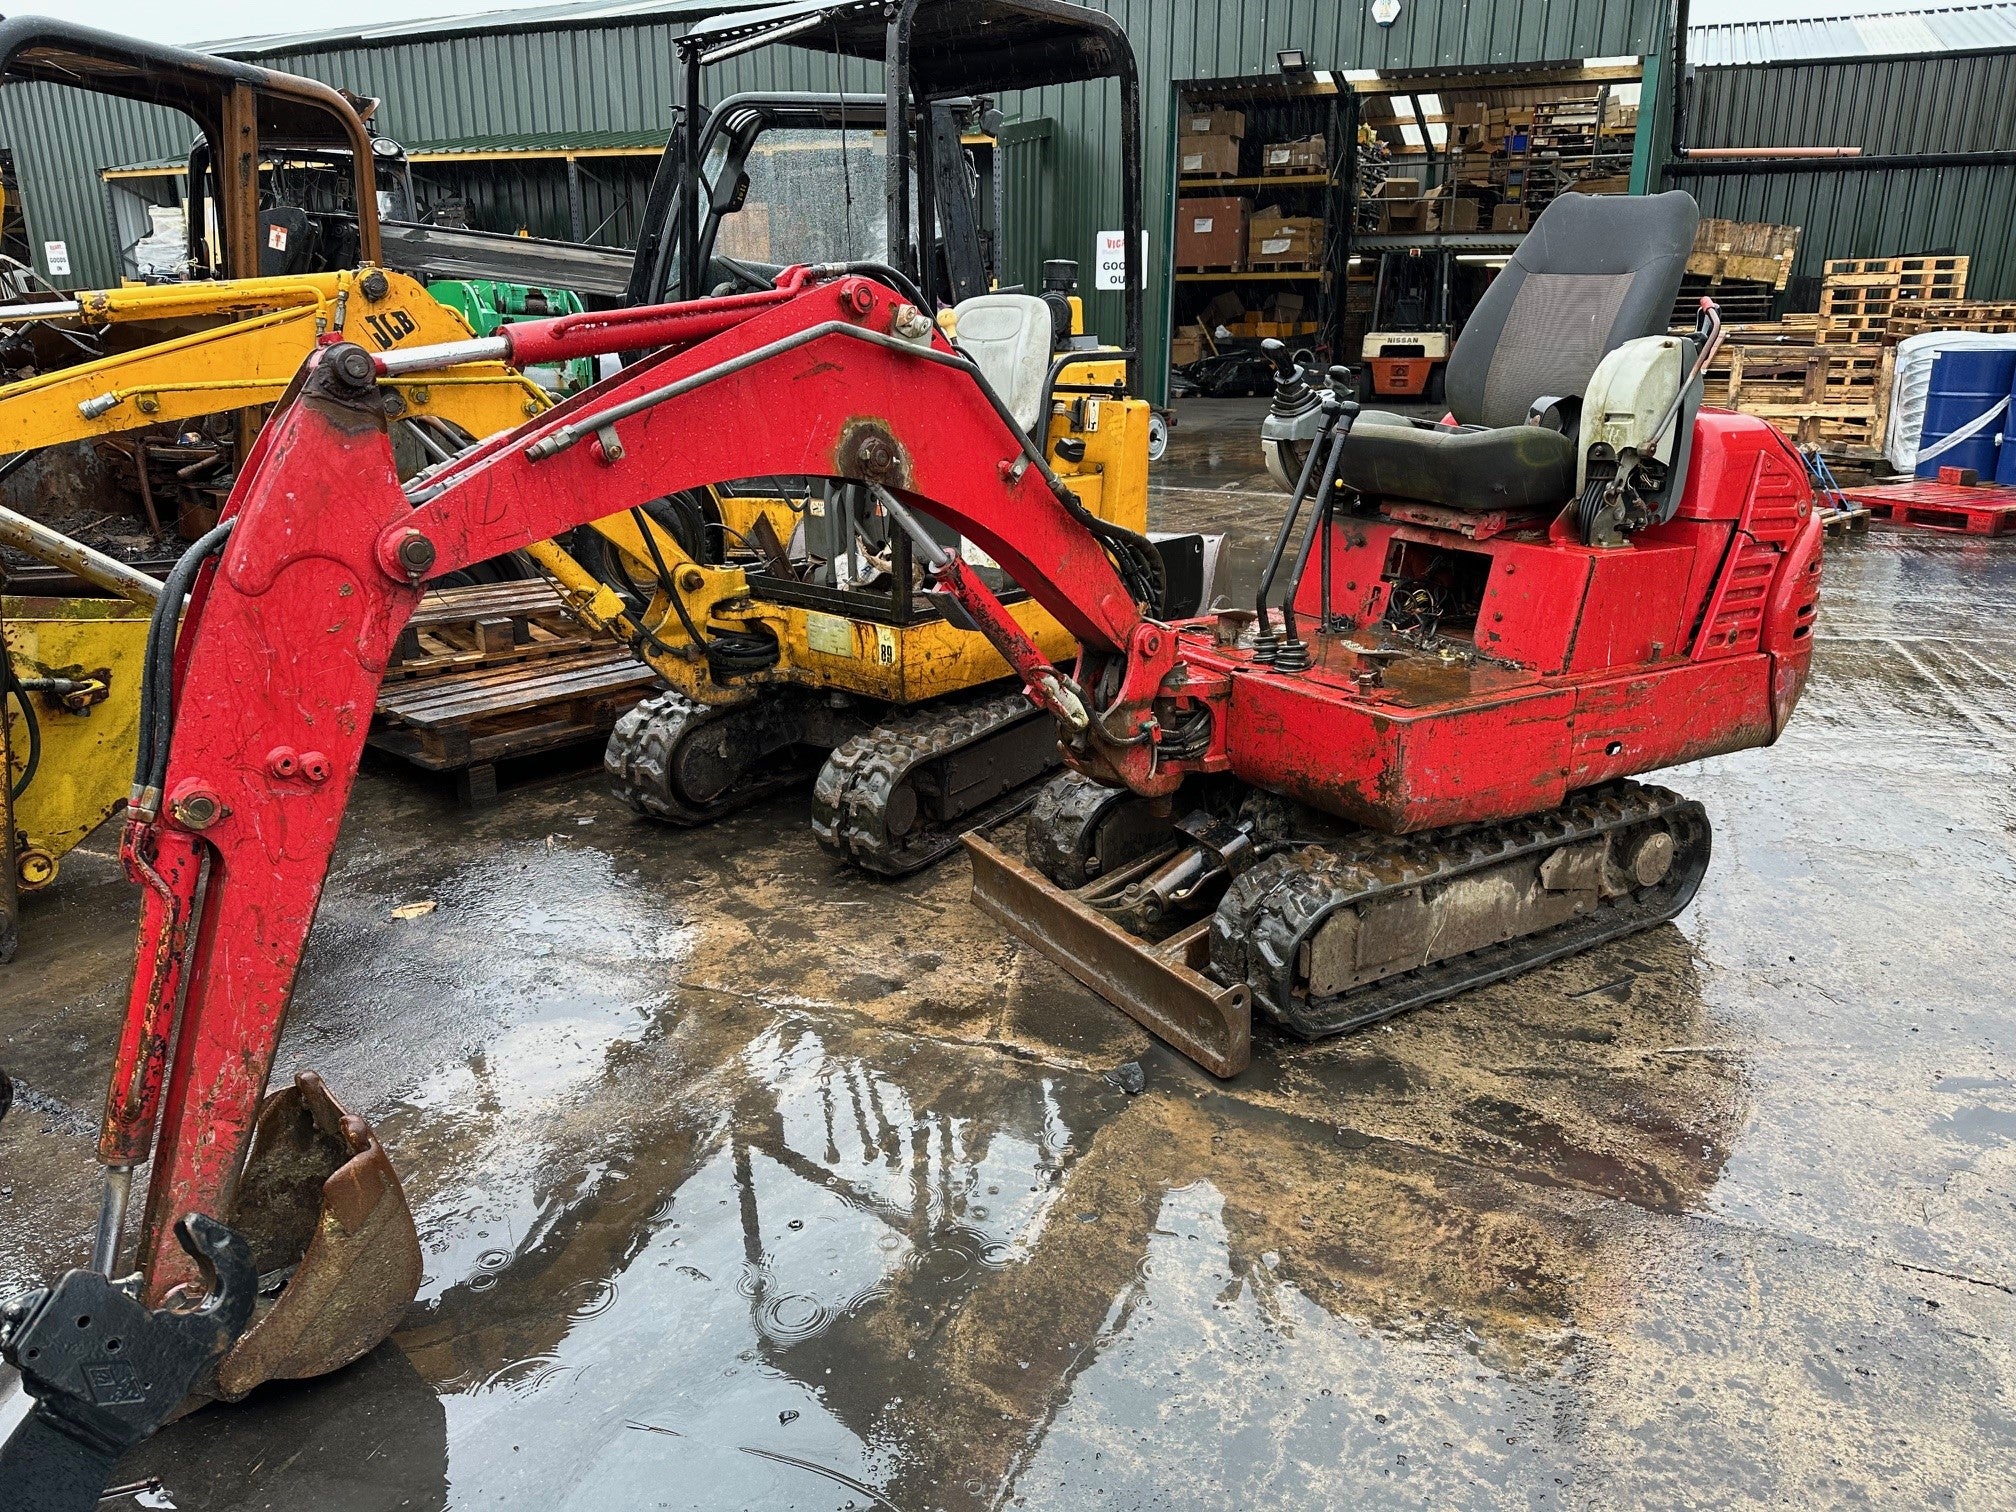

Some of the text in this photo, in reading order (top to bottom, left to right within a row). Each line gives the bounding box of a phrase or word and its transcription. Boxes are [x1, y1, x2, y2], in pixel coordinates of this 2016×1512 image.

[1110, 276, 1125, 284] OU
[365, 311, 415, 350] JCB
[881, 644, 893, 663] 89
